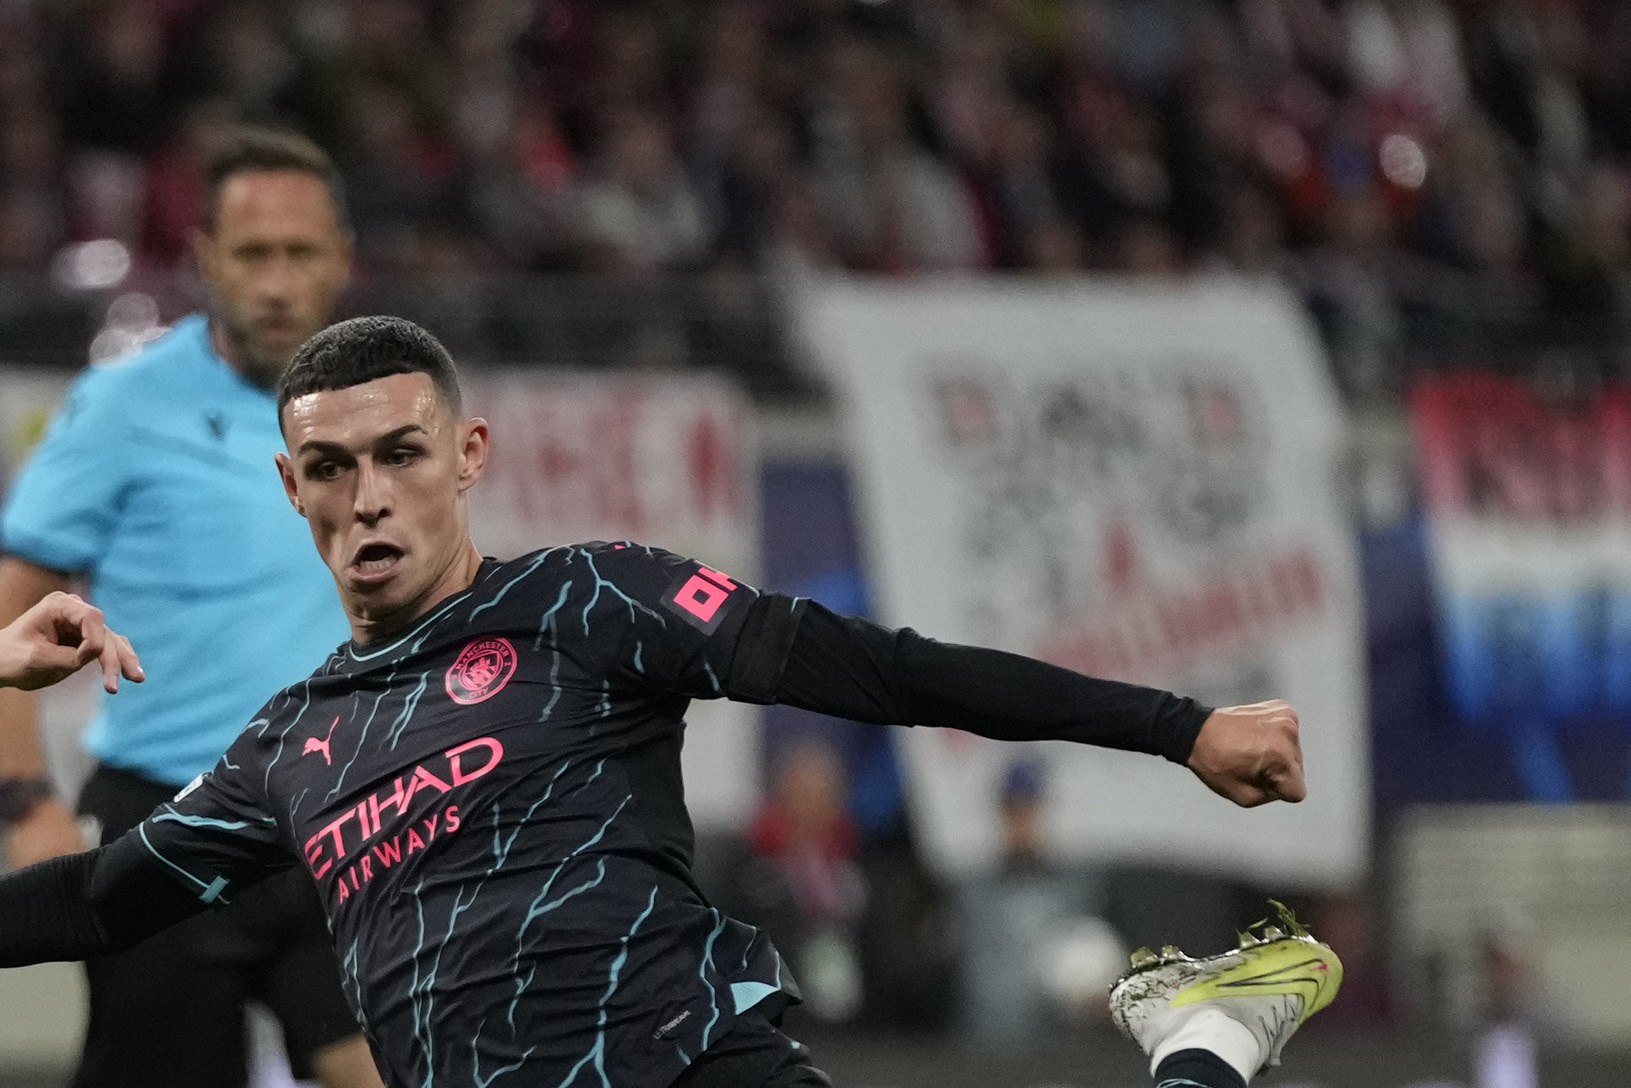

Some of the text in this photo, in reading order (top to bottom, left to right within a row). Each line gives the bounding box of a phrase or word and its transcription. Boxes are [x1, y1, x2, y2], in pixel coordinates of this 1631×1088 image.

[455, 641, 510, 670] MANCHESTER
[469, 688, 489, 699] CITY
[304, 736, 505, 880] ETIHAD
[338, 804, 461, 905] AIRWAYS
